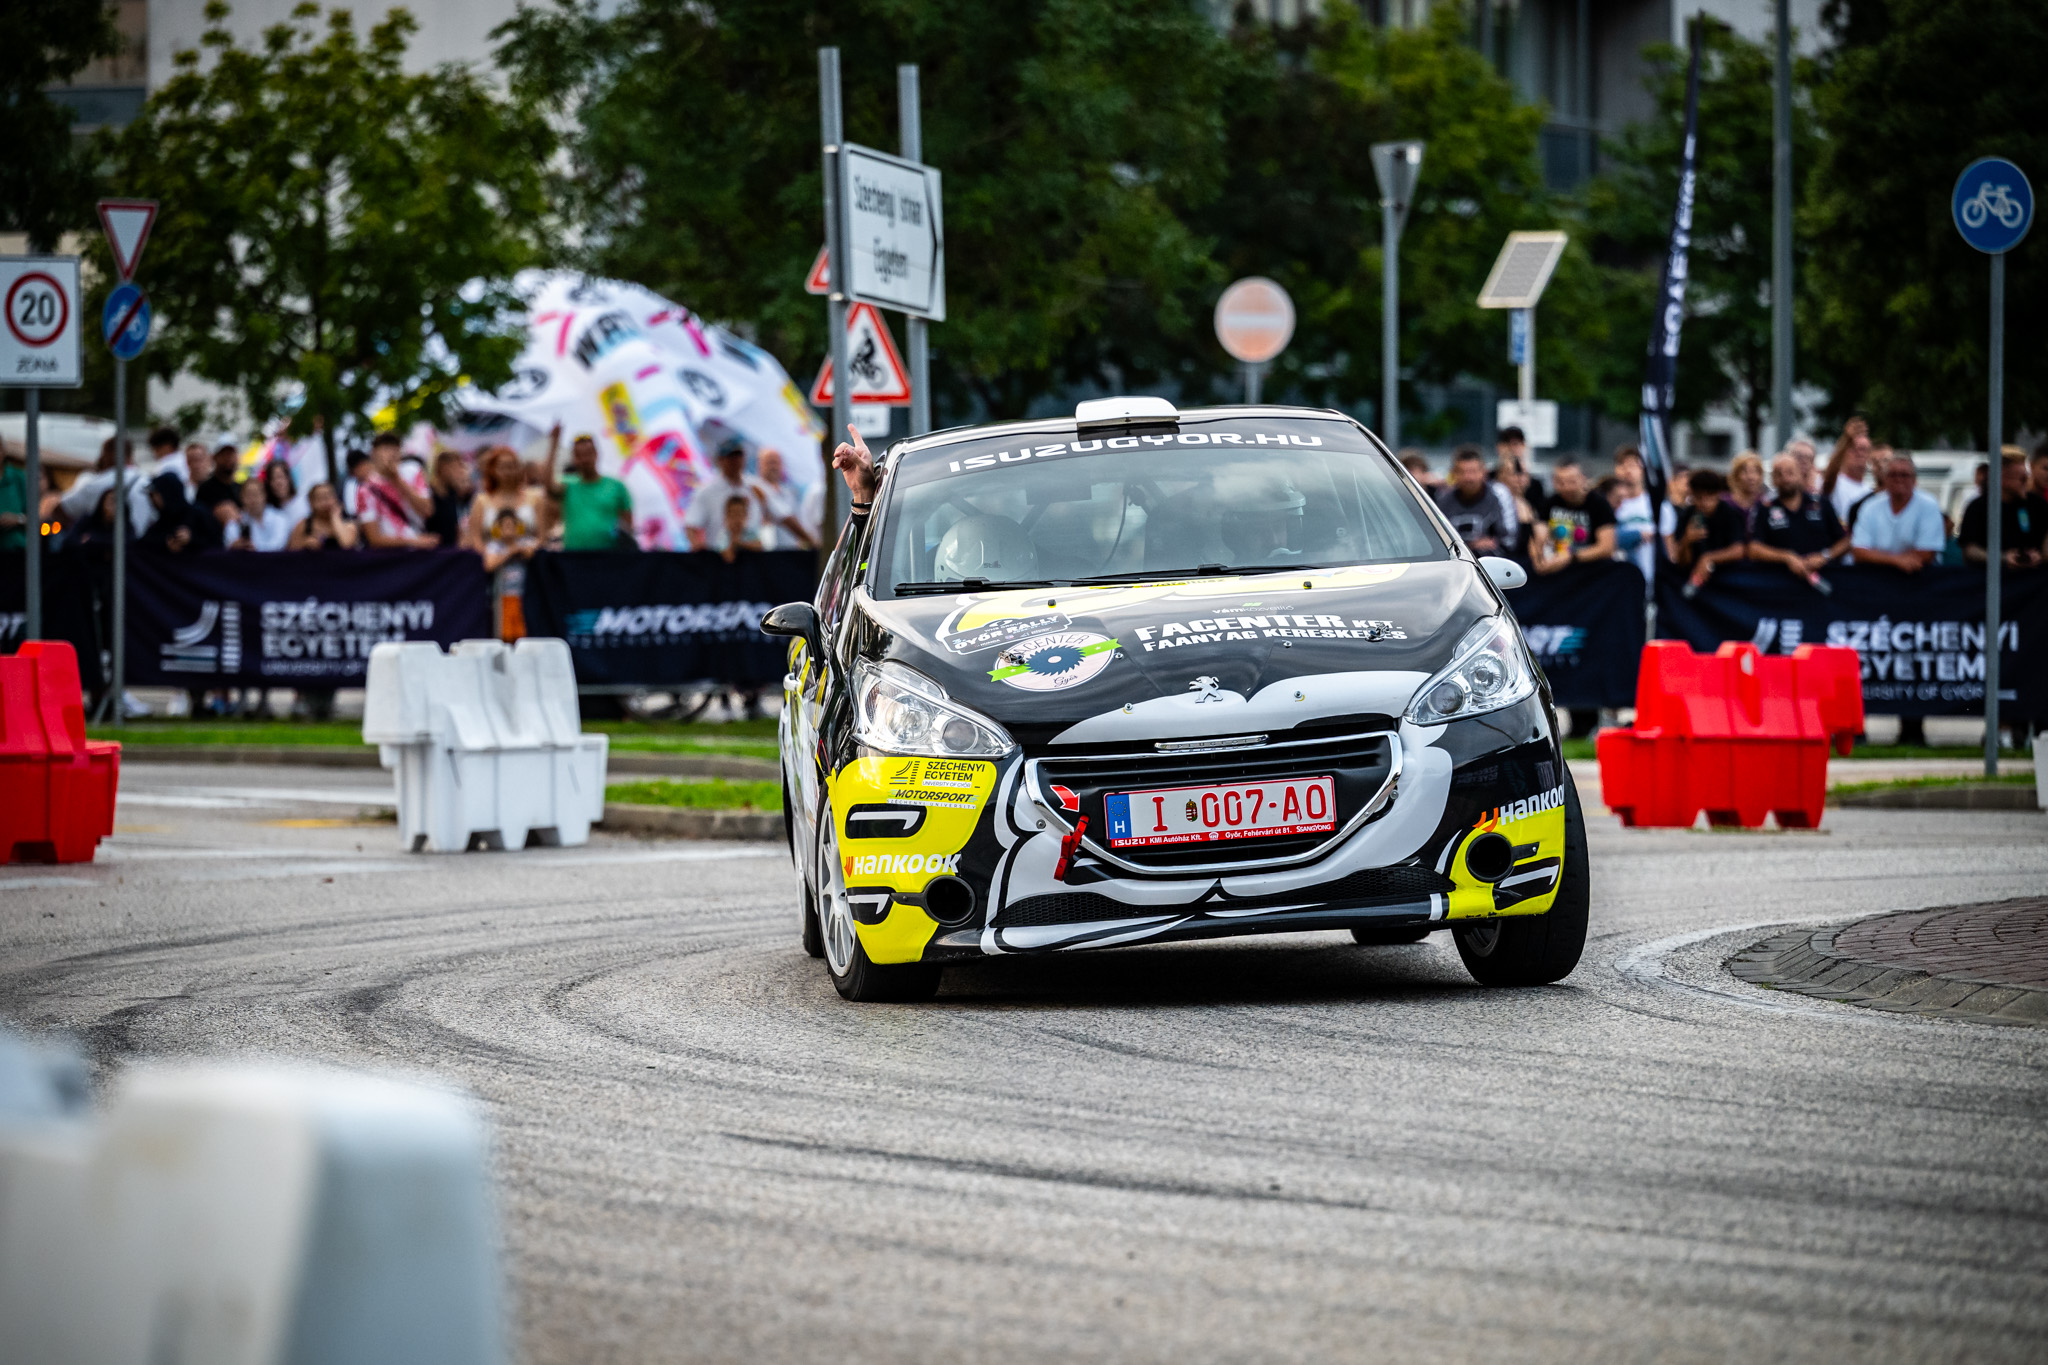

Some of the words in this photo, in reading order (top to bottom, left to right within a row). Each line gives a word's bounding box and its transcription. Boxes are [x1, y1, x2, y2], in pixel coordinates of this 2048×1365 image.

[20, 290, 55, 326] 20
[949, 432, 1323, 473] ISUZUGYOR.HU
[261, 596, 435, 630] SZÉCHENYI
[1006, 615, 1060, 634] RALLY
[1134, 614, 1347, 641] FACENTER
[1012, 634, 1090, 654] ACENTER
[1142, 632, 1259, 652] FAANYAG
[924, 771, 973, 781] EGYETEM
[926, 760, 985, 772] SZÉCHENYI
[895, 789, 973, 802] MOTORSPORT
[1151, 796, 1168, 832] I
[1114, 838, 1146, 846] ISUZU
[1163, 835, 1190, 843] Autóház
[1225, 831, 1243, 839] Győr,
[1243, 828, 1274, 837] Fehérvári
[1115, 820, 1126, 834] H
